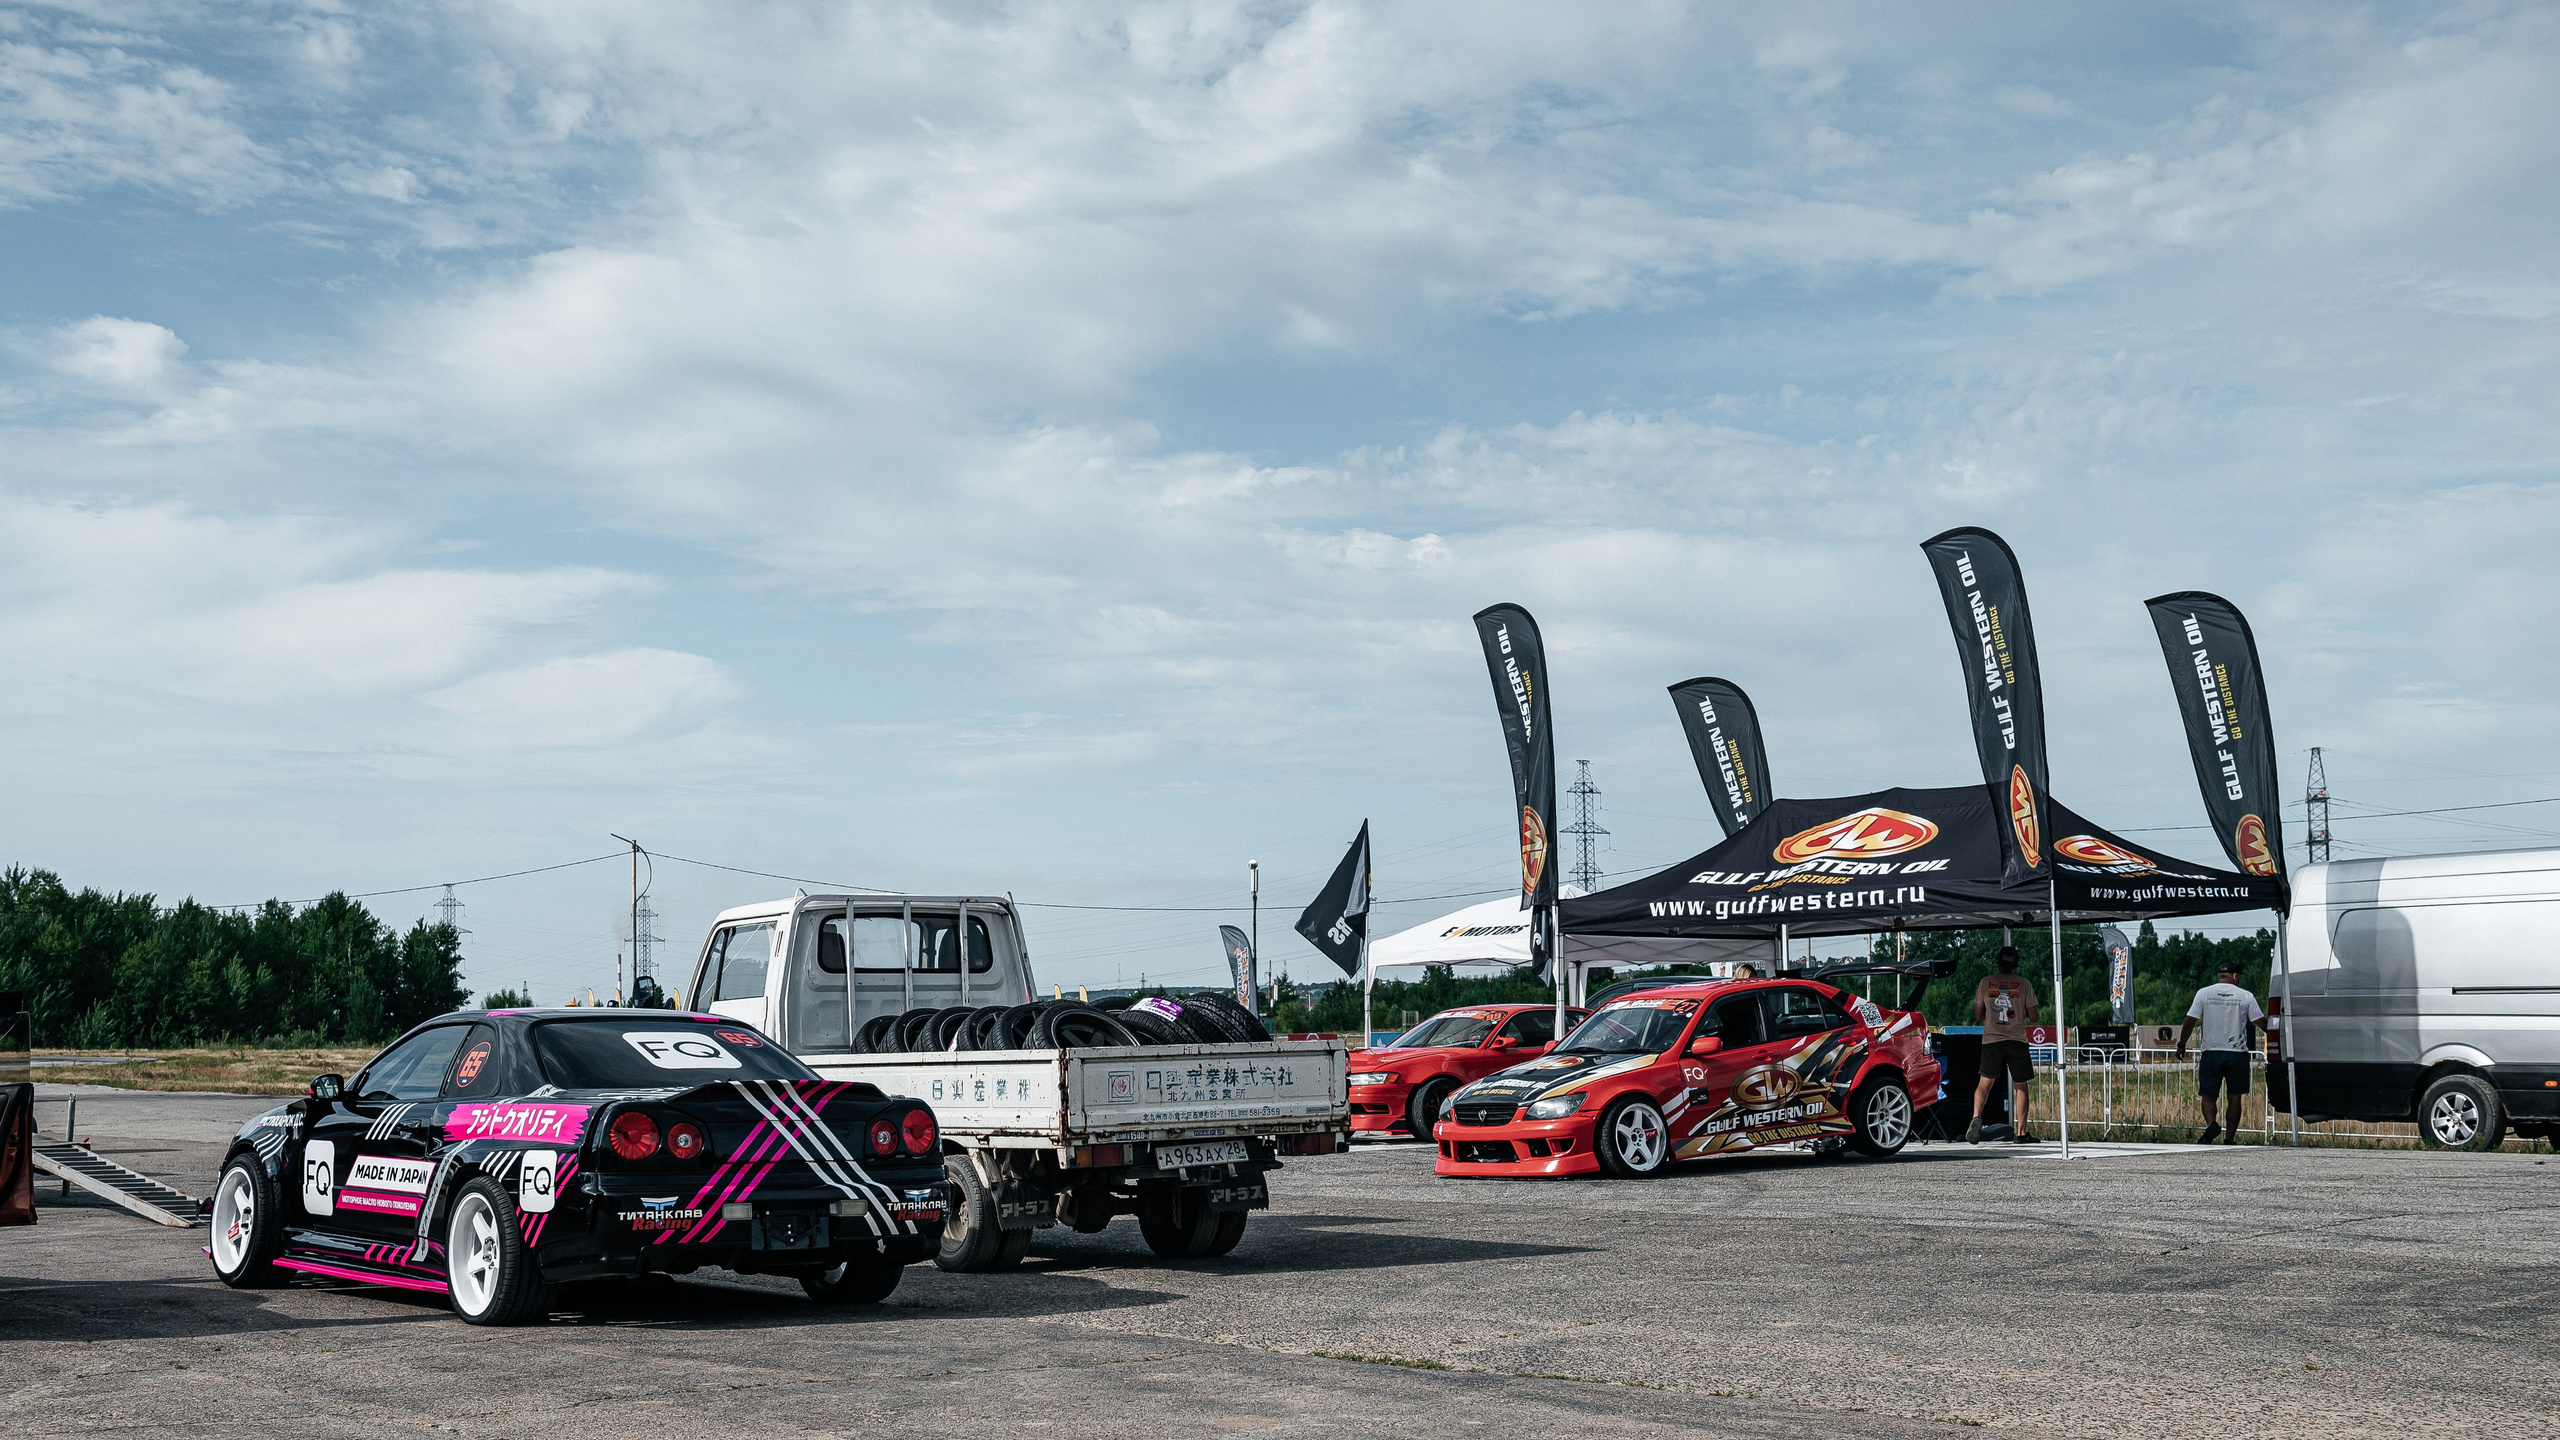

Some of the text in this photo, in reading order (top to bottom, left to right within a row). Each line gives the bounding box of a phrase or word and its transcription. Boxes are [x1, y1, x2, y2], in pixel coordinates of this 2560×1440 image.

[1497, 623, 1513, 656] OIL
[1989, 605, 2016, 685] GO THE DISTANCE
[1956, 551, 2016, 750] GULF WESTERN OIL
[1699, 695, 1717, 725] OIL
[2182, 612, 2243, 801] GULF WESTERN OIL
[2214, 663, 2243, 740] GO THE DISTANCE
[1708, 727, 1743, 809] WESTERN
[1727, 738, 1753, 803] GO THE DISTANCE
[1689, 858, 1950, 885] GULF WESTERN OIL
[1788, 874, 1854, 885] DISTANCE
[1649, 886, 1926, 920] www.gulfwestern.ru
[2090, 884, 2249, 902] www.gulfwestern.ru
[1458, 924, 1530, 938] MOTORS
[1675, 1002, 1699, 1012] 27
[719, 1032, 759, 1045] 65
[637, 1041, 724, 1060] FQ
[459, 1051, 488, 1077] 65
[1683, 1067, 1705, 1083] FQ
[466, 1105, 568, 1138] フジトクオリティ
[1270, 1125, 1300, 1133] Atlas
[1707, 1116, 1741, 1135] GULF
[1743, 1104, 1804, 1127] WESTERN
[1747, 1123, 1823, 1143] GO THE DISTANCE
[1226, 1142, 1241, 1155] 28
[305, 1159, 331, 1197] FQ
[355, 1164, 429, 1185] MADE IN JAPAN
[522, 1166, 552, 1196] FQ
[1210, 1185, 1265, 1203] アトラス
[617, 1209, 703, 1221] ТИТАНКЛАВ
[897, 1207, 941, 1222] Racing
[1001, 1200, 1050, 1218] アトラス
[632, 1216, 693, 1232] Racing
